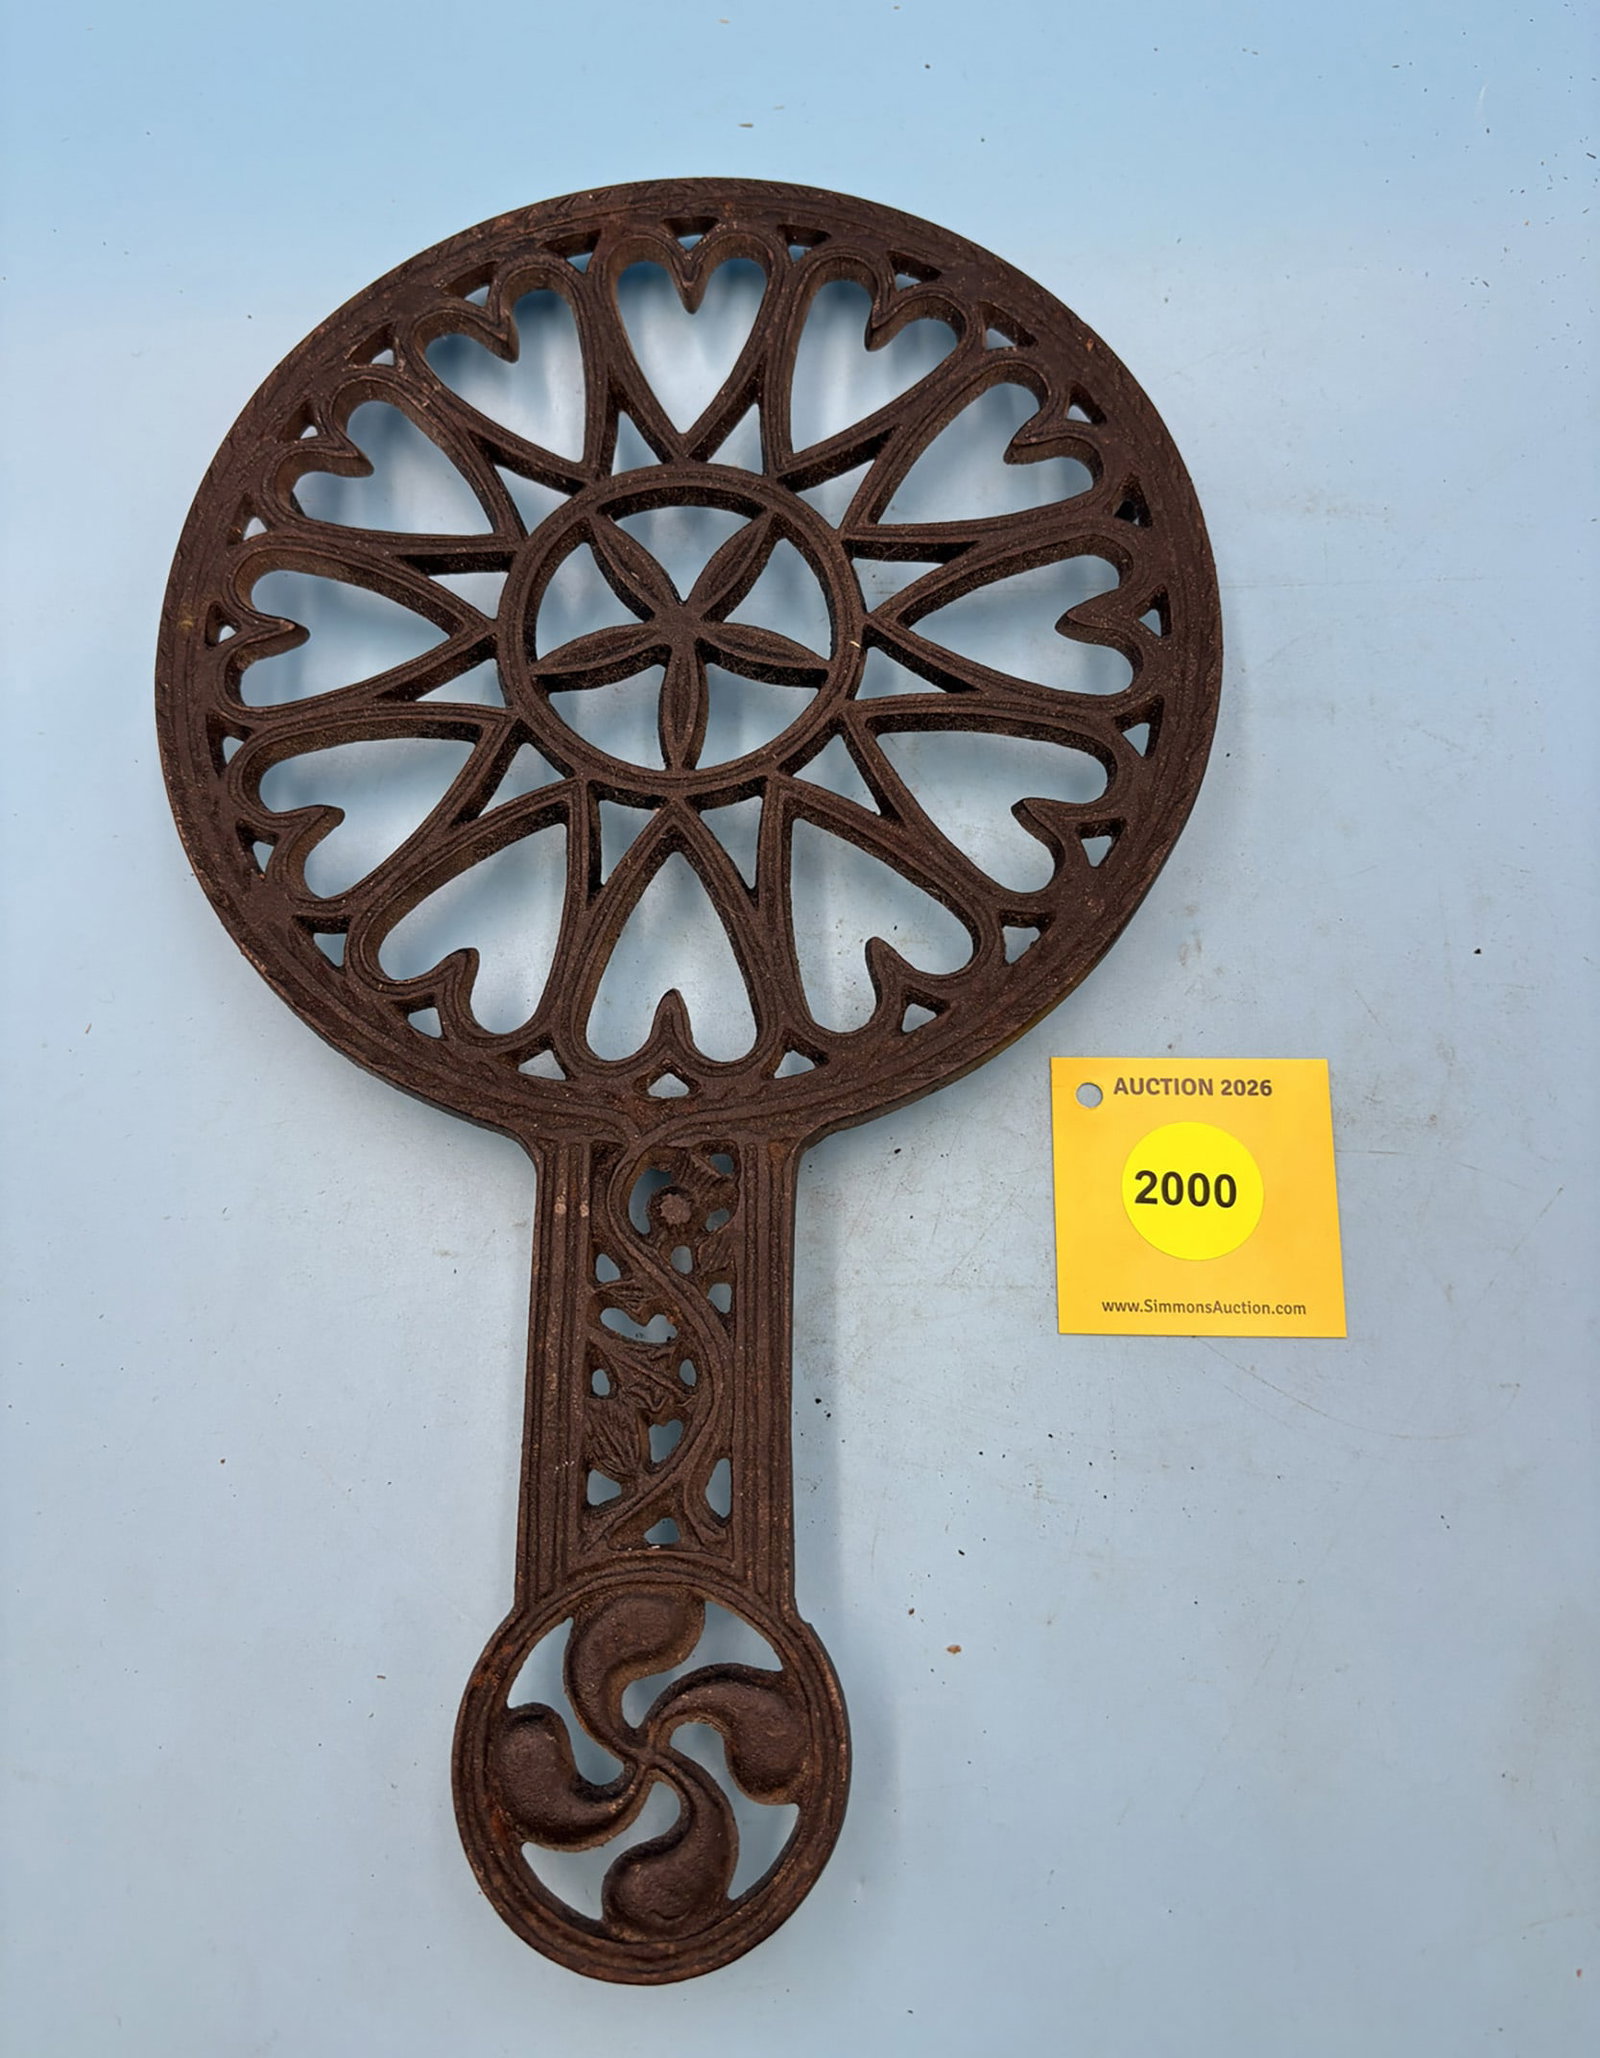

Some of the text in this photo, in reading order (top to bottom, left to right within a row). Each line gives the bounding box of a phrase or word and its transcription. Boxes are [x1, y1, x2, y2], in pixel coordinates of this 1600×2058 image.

[1113, 1077, 1273, 1097] AUCTION 2026
[1134, 1169, 1237, 1208] 2000
[1101, 1299, 1307, 1315] www.SimmonsAuction.com
